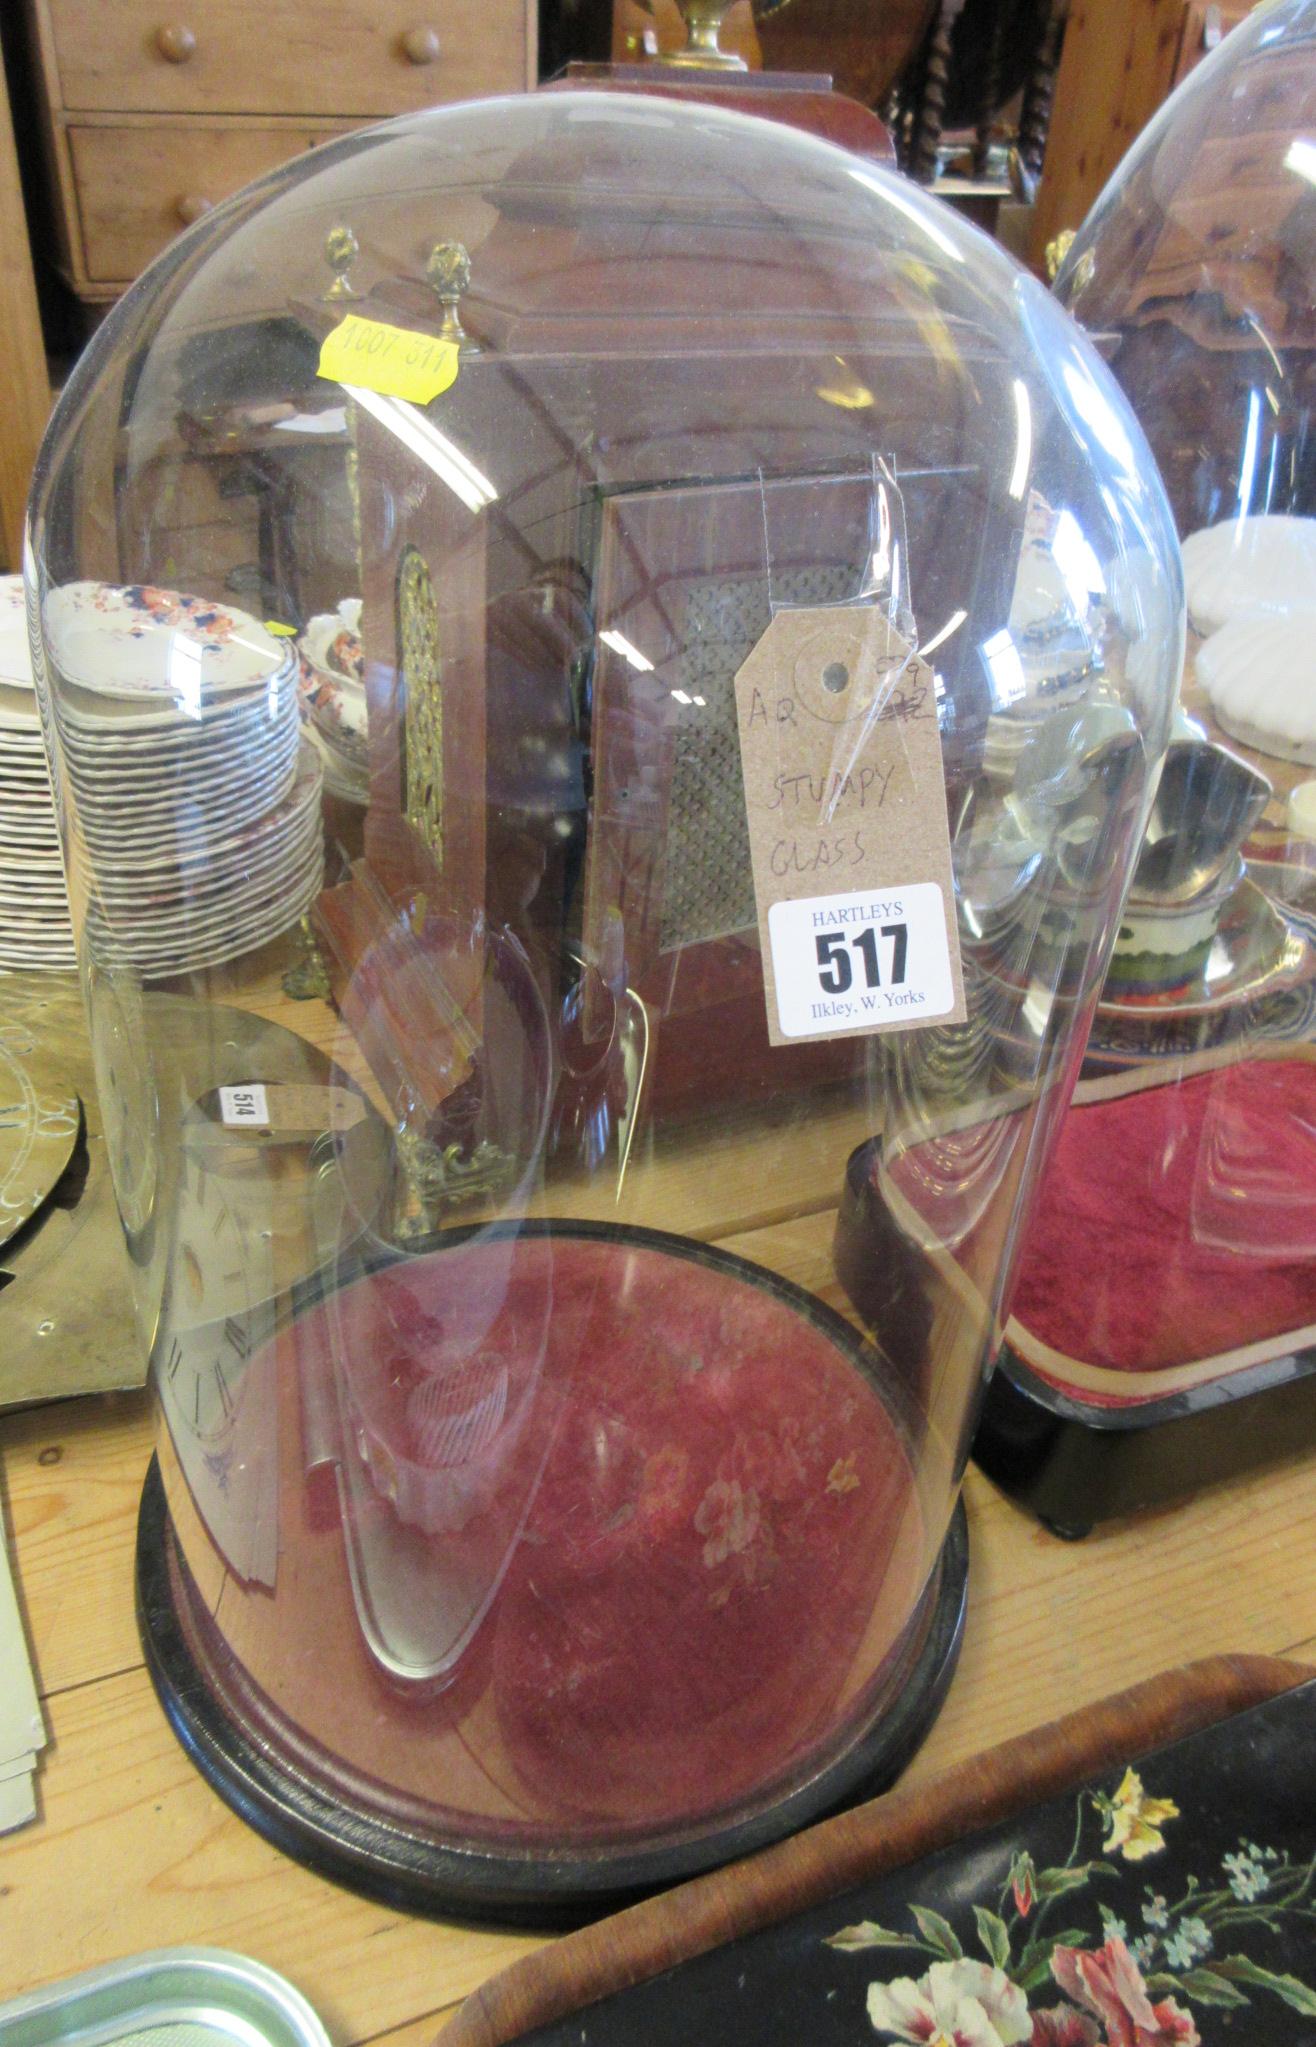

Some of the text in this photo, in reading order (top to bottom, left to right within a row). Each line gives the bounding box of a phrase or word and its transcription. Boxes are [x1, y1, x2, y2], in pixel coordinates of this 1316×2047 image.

[343, 323, 400, 357] 1007
[770, 831, 865, 876] GLASS
[812, 901, 904, 927] HARTLEYS
[815, 923, 908, 995] 517
[811, 989, 926, 1019] Ilkley, W. Yorks
[233, 1093, 256, 1116] 514
